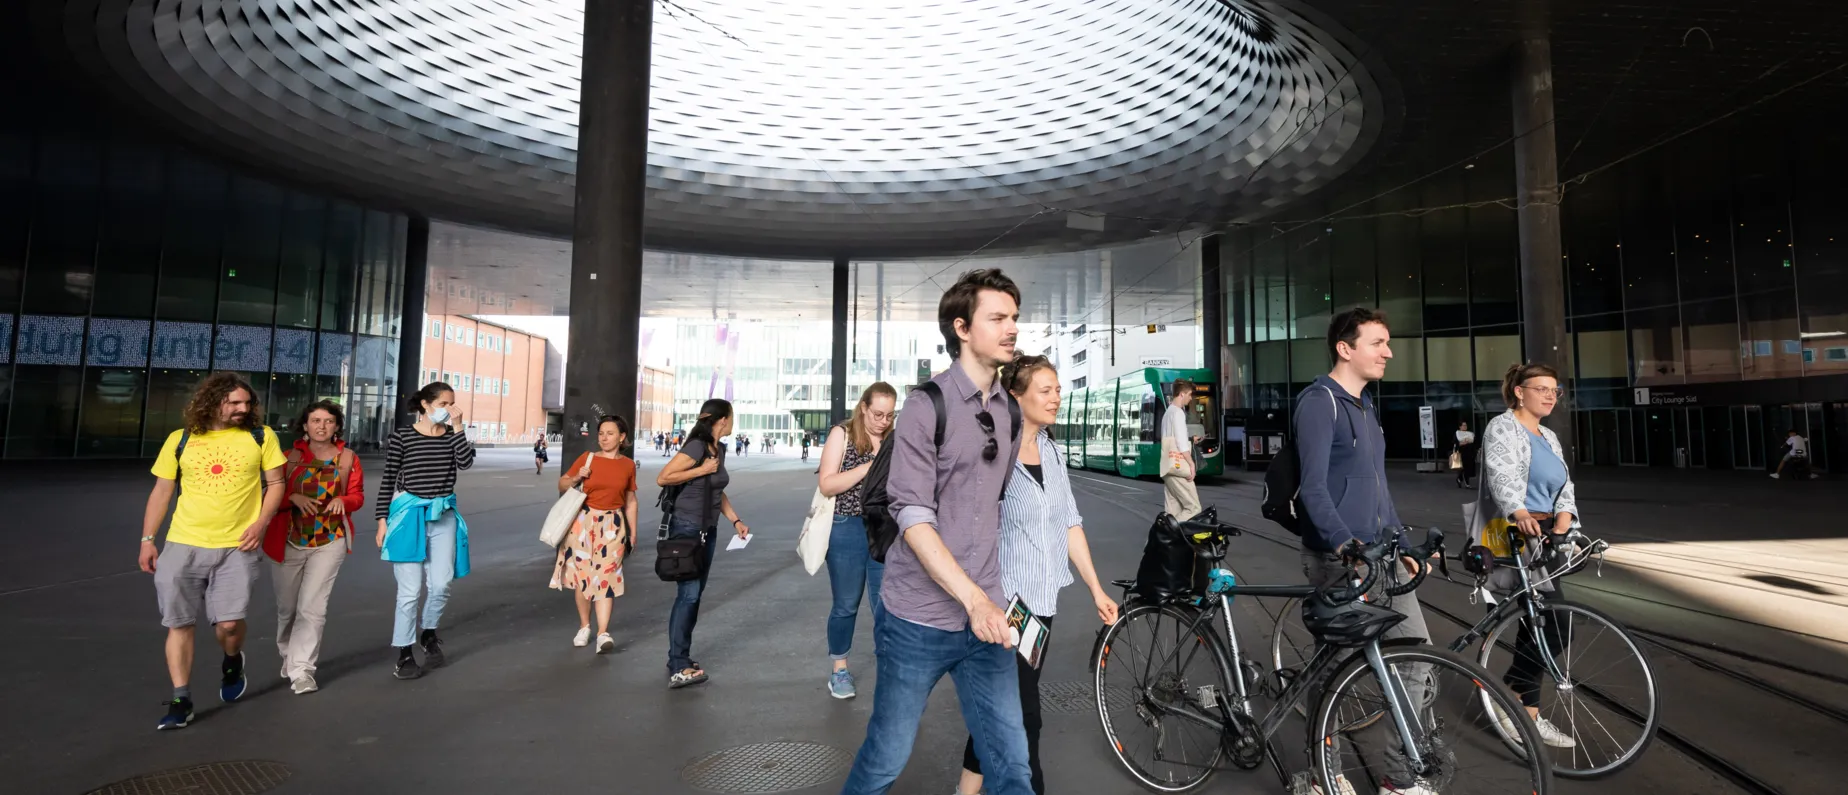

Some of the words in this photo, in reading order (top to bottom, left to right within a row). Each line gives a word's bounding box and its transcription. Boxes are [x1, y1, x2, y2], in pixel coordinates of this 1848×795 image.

[141, 333, 251, 361] unter
[921, 360, 928, 369] C
[1651, 397, 1663, 405] City
[1664, 397, 1684, 405] Lounge
